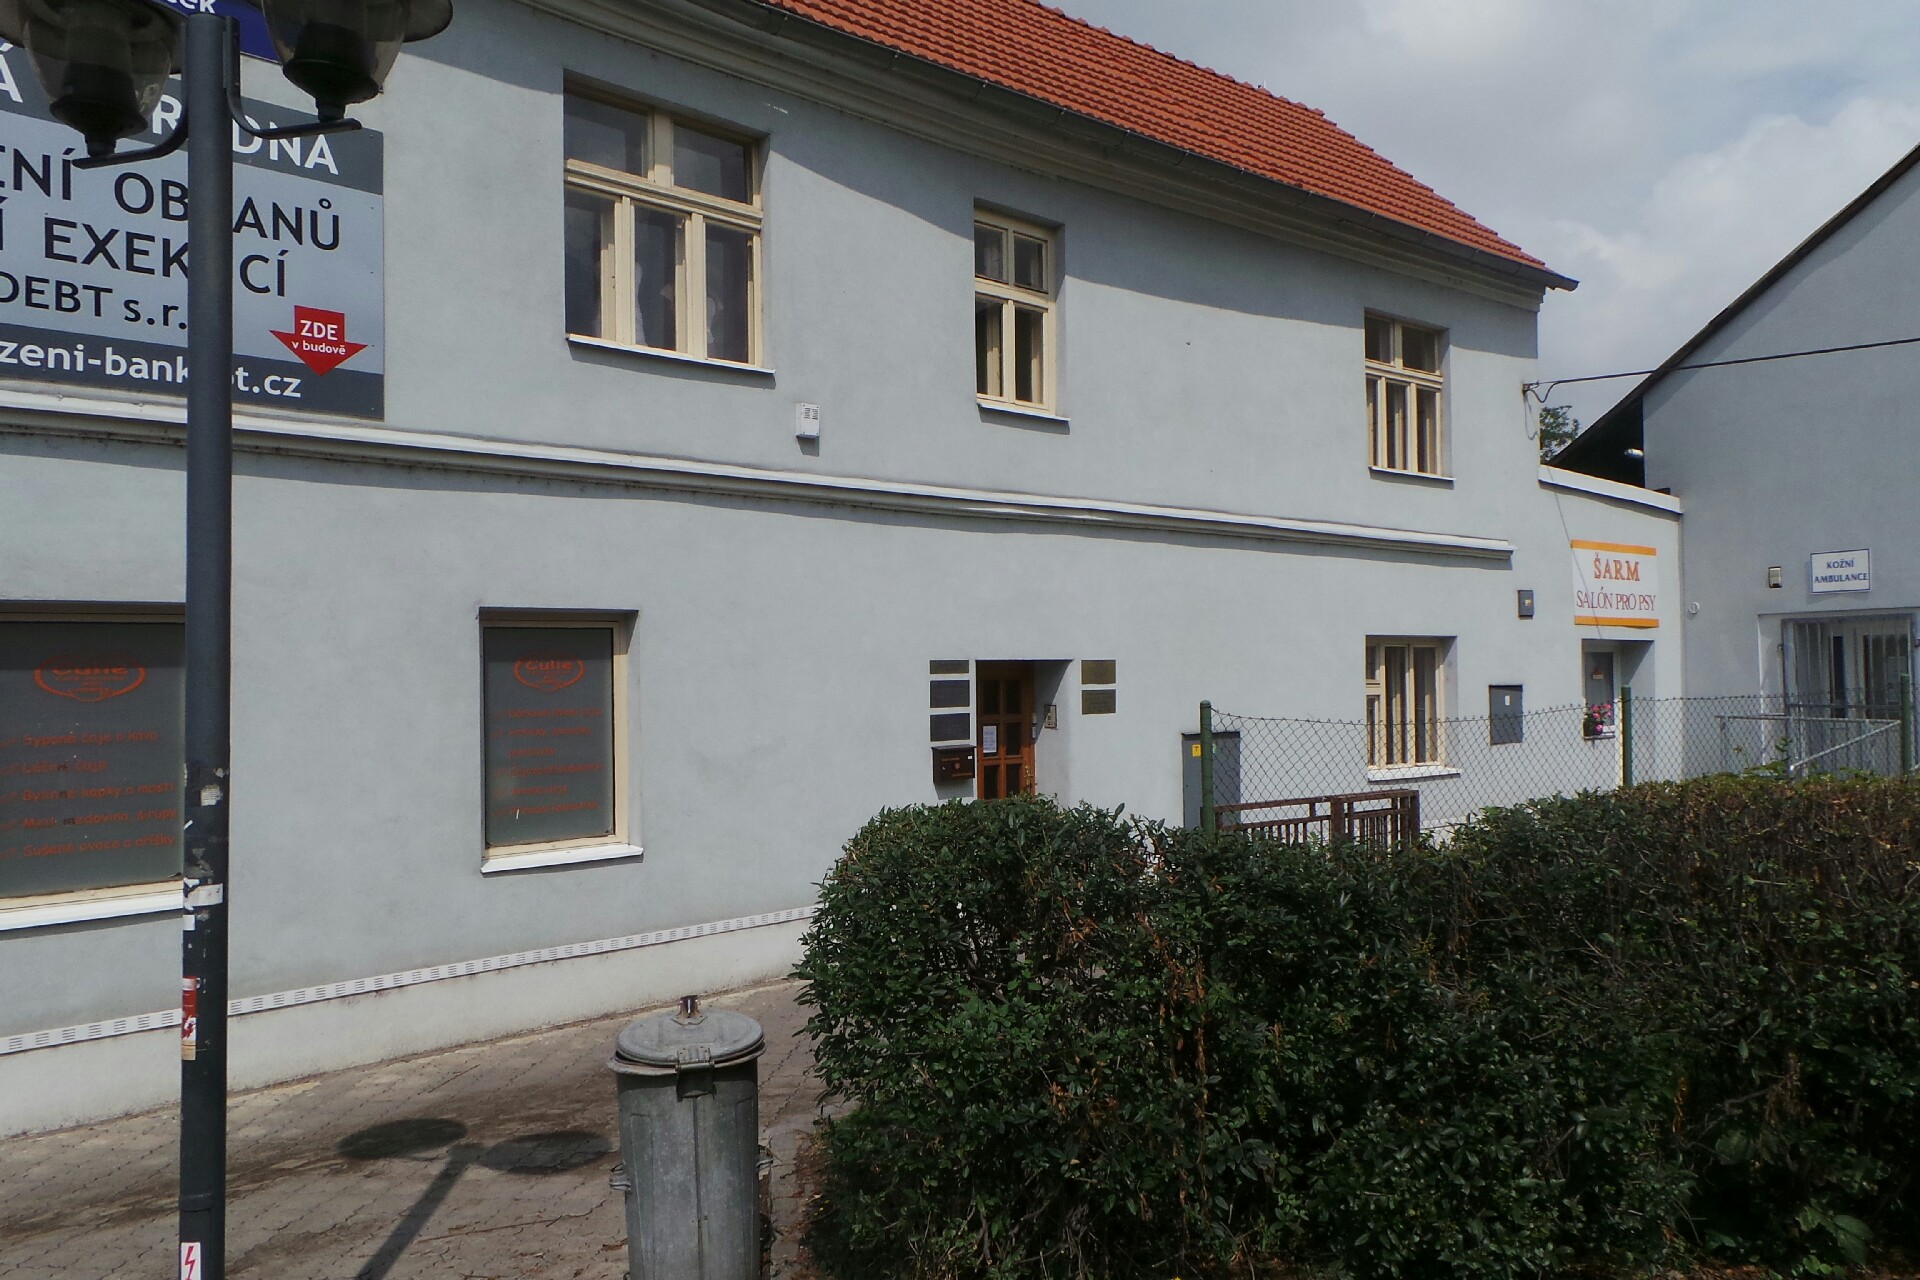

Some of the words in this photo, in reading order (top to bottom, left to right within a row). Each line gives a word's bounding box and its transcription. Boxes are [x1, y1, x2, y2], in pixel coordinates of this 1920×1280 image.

[0, 144, 76, 201] NÍ
[114, 171, 340, 251] OBANŮ
[44, 216, 289, 298] EXEKCÍ
[300, 319, 339, 341] ZDE
[291, 341, 299, 349] v
[302, 340, 346, 355] budově
[1593, 552, 1640, 582] ŠARM
[1826, 557, 1855, 569] KOŽNÍ
[1814, 572, 1869, 583] AMBULANCE
[1576, 586, 1613, 609] SALÓN
[1615, 593, 1637, 611] PRO
[1638, 594, 1656, 611] PSY
